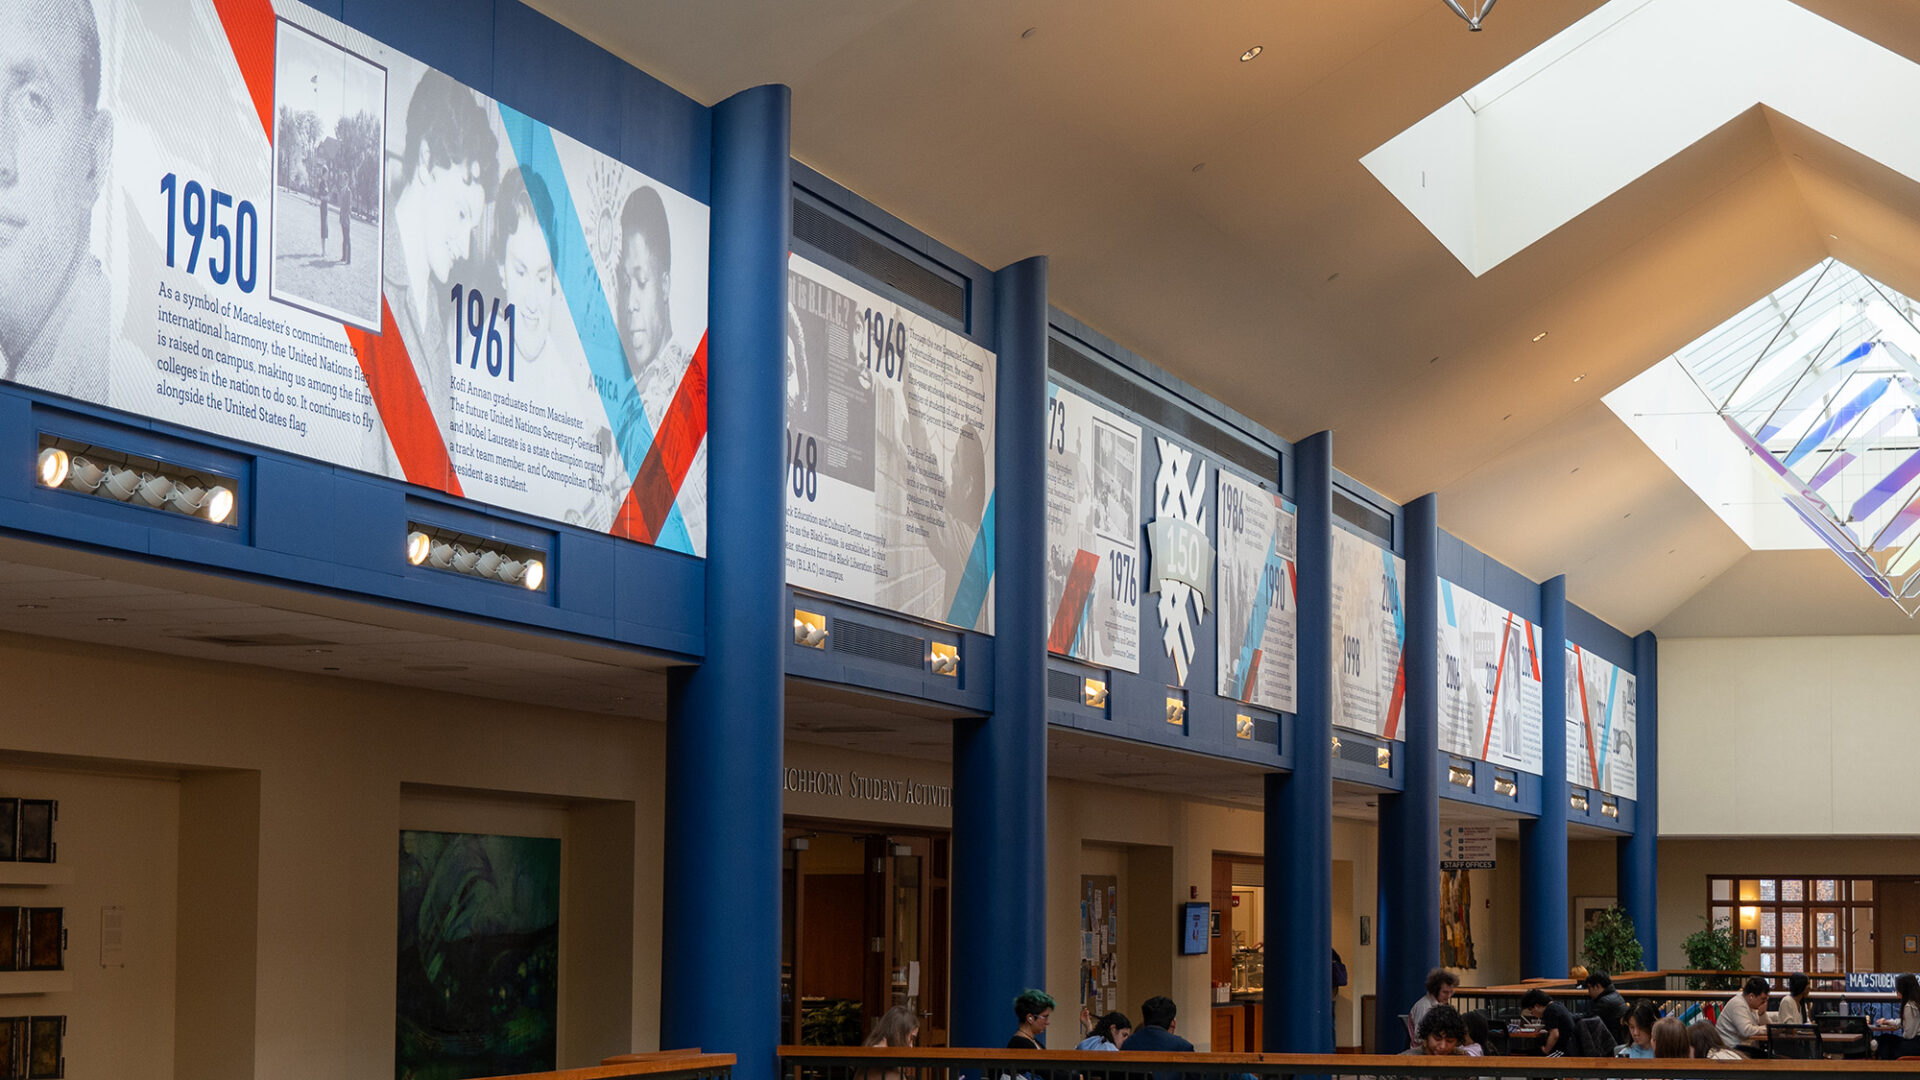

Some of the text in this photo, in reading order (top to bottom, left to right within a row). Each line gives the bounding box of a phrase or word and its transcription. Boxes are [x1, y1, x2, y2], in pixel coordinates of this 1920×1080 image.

[160, 171, 257, 294] 1950
[158, 281, 357, 357] As a symbol of Macalester's commitment to
[158, 305, 370, 387] international harmony, the United Nations flag
[450, 282, 515, 382] 1961
[864, 307, 905, 382] 1969
[157, 330, 372, 406] is raised on campus, making us among the first
[157, 353, 373, 433] colleges in the nation to do so. It continues to fly
[587, 375, 619, 402] AFRICA
[157, 377, 307, 437] alongside the United States flag.
[450, 375, 465, 393] Kofi
[467, 381, 491, 401] Annan
[493, 389, 527, 416] graduates
[529, 399, 545, 418] from
[449, 416, 463, 433] and
[465, 421, 486, 440] Nobel
[488, 429, 518, 449] Laureate
[519, 438, 525, 451] is
[527, 444, 531, 453] a
[532, 443, 549, 458] state
[550, 446, 583, 472] champion
[450, 396, 601, 457] The future United Nations Secretary-General
[1049, 398, 1065, 454] 73
[449, 441, 454, 451] a
[455, 439, 474, 457] track
[476, 448, 494, 463] team
[527, 460, 539, 475] and
[541, 464, 586, 492] Cosmopolitan
[449, 459, 527, 492] president as a student.
[787, 428, 817, 503] 68
[794, 507, 817, 524] Education
[818, 514, 827, 527] and
[810, 528, 823, 542] Black
[1222, 482, 1244, 534] 1986
[1109, 549, 1137, 607] 1976
[1167, 524, 1200, 581] 150
[1264, 563, 1286, 611] 1990
[1381, 573, 1399, 616] 2004
[1343, 634, 1360, 677] 1998
[783, 767, 952, 808] ICHHORN STUDENT ACTIVITI
[1444, 861, 1492, 869] STAFF OFFICES
[1849, 973, 1869, 988] MAC
